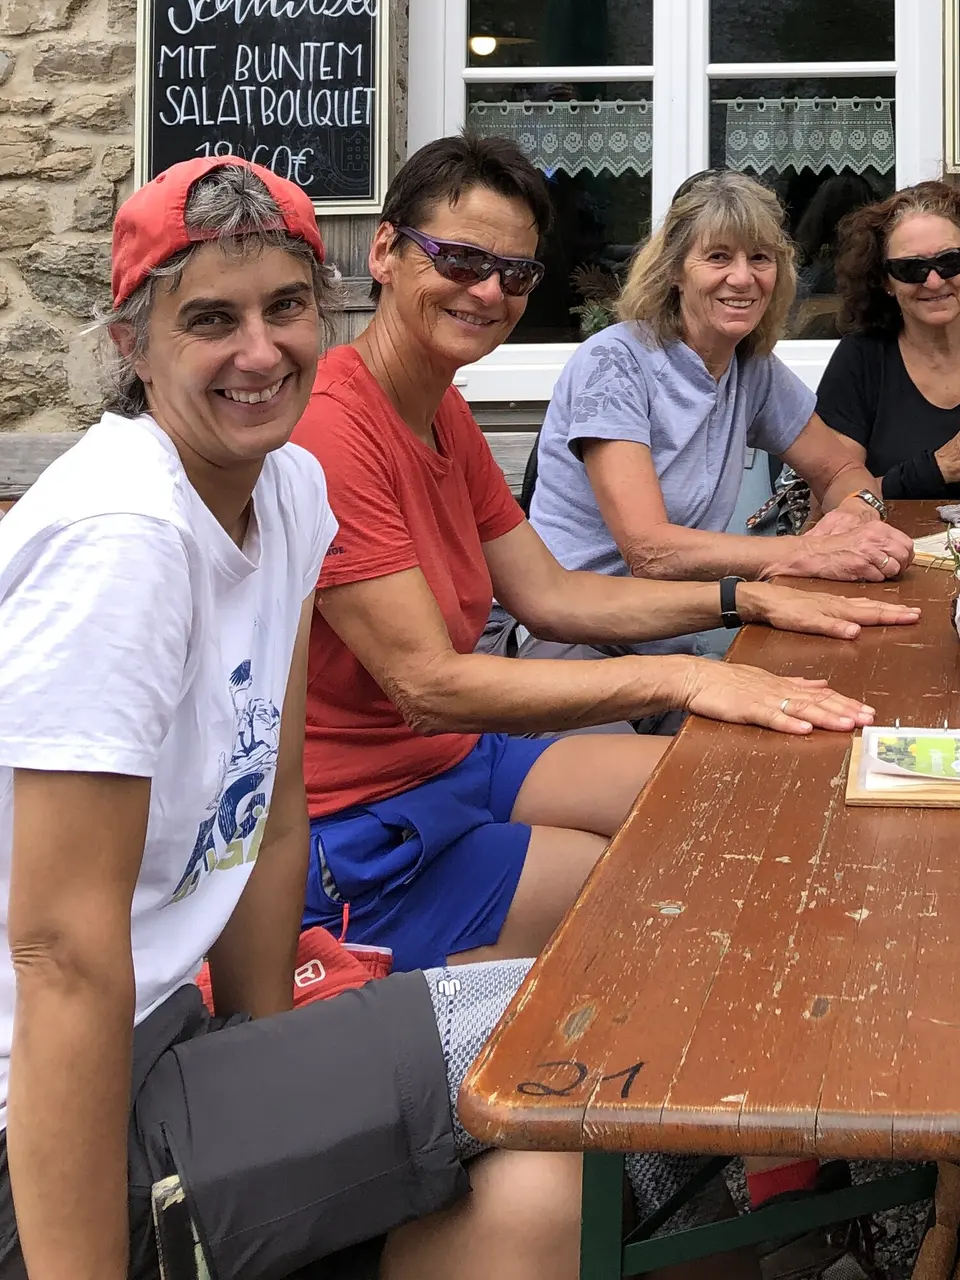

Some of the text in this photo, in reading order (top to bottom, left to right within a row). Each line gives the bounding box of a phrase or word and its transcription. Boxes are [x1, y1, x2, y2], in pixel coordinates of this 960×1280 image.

[158, 41, 363, 83] MIT BUNTEM
[516, 1061, 646, 1099] 21
